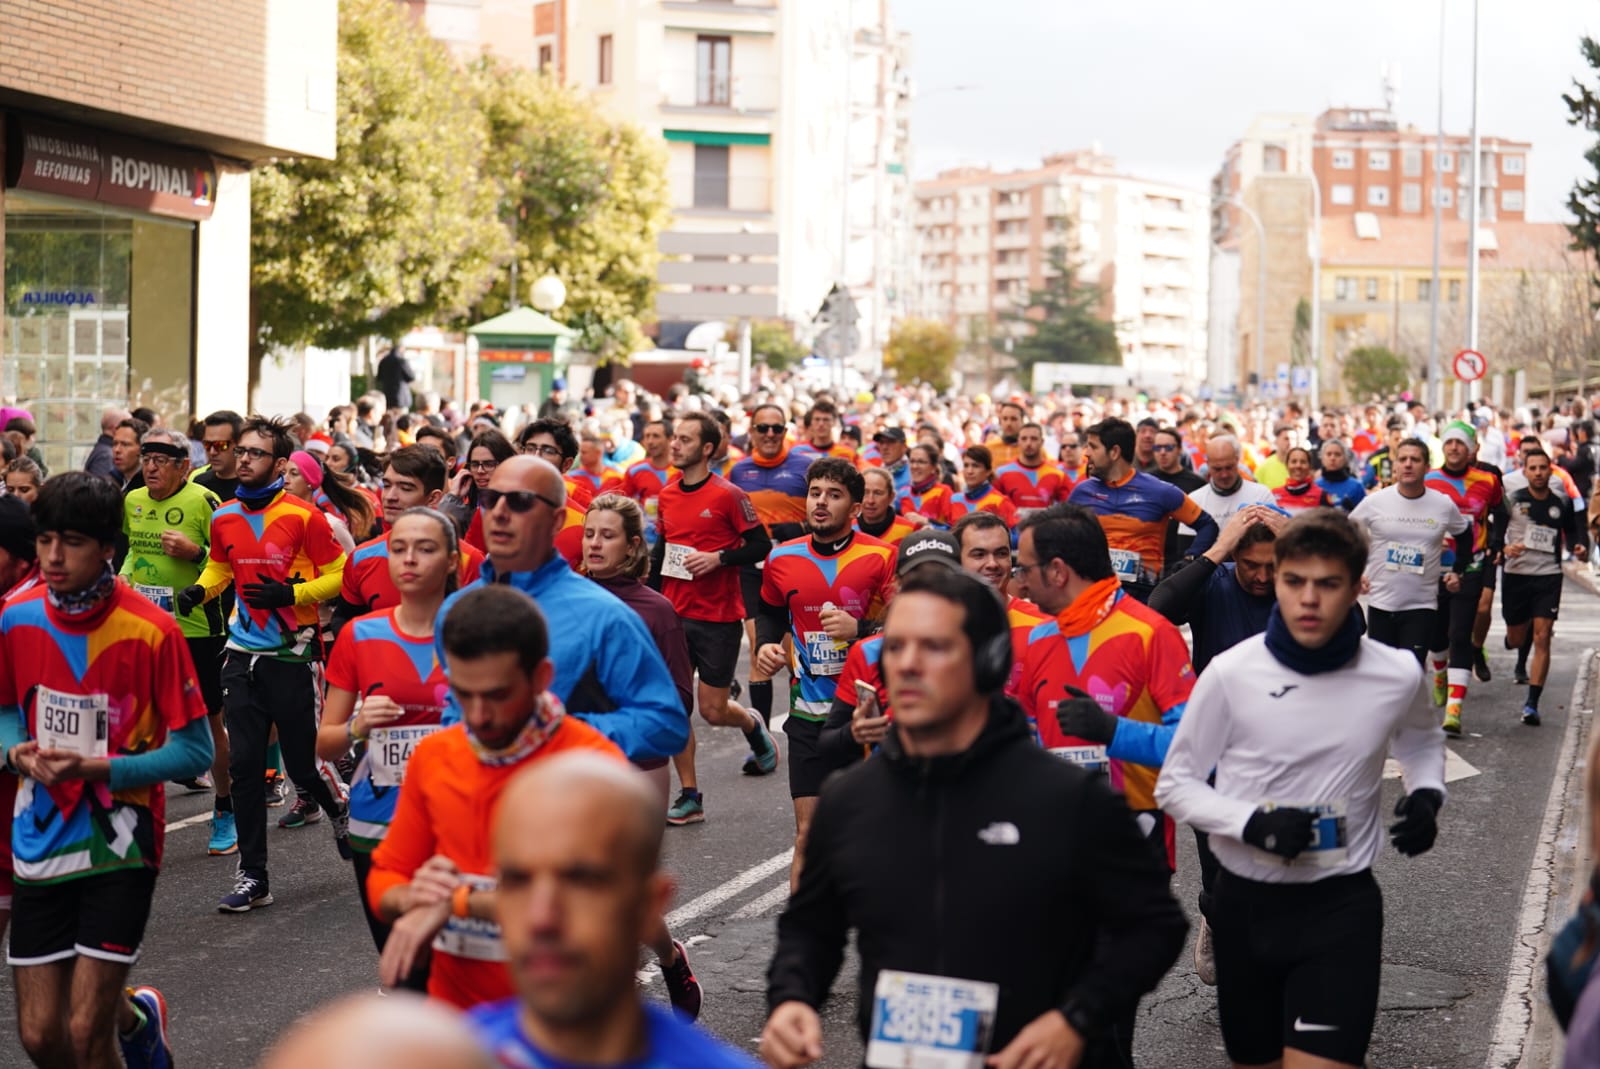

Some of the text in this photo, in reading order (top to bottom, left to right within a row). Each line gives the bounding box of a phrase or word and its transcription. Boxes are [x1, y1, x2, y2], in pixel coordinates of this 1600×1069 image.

[27, 134, 100, 162] INMOBILIARIA
[34, 159, 91, 185] REFORMAS
[110, 155, 192, 197] ROPINAL
[905, 539, 953, 556] adidas
[140, 586, 168, 595] SETEL
[49, 694, 98, 709] SETEL
[44, 706, 80, 735] 930
[383, 742, 412, 766] 164
[906, 983, 977, 1001] SETEL
[882, 997, 963, 1046] 3895
